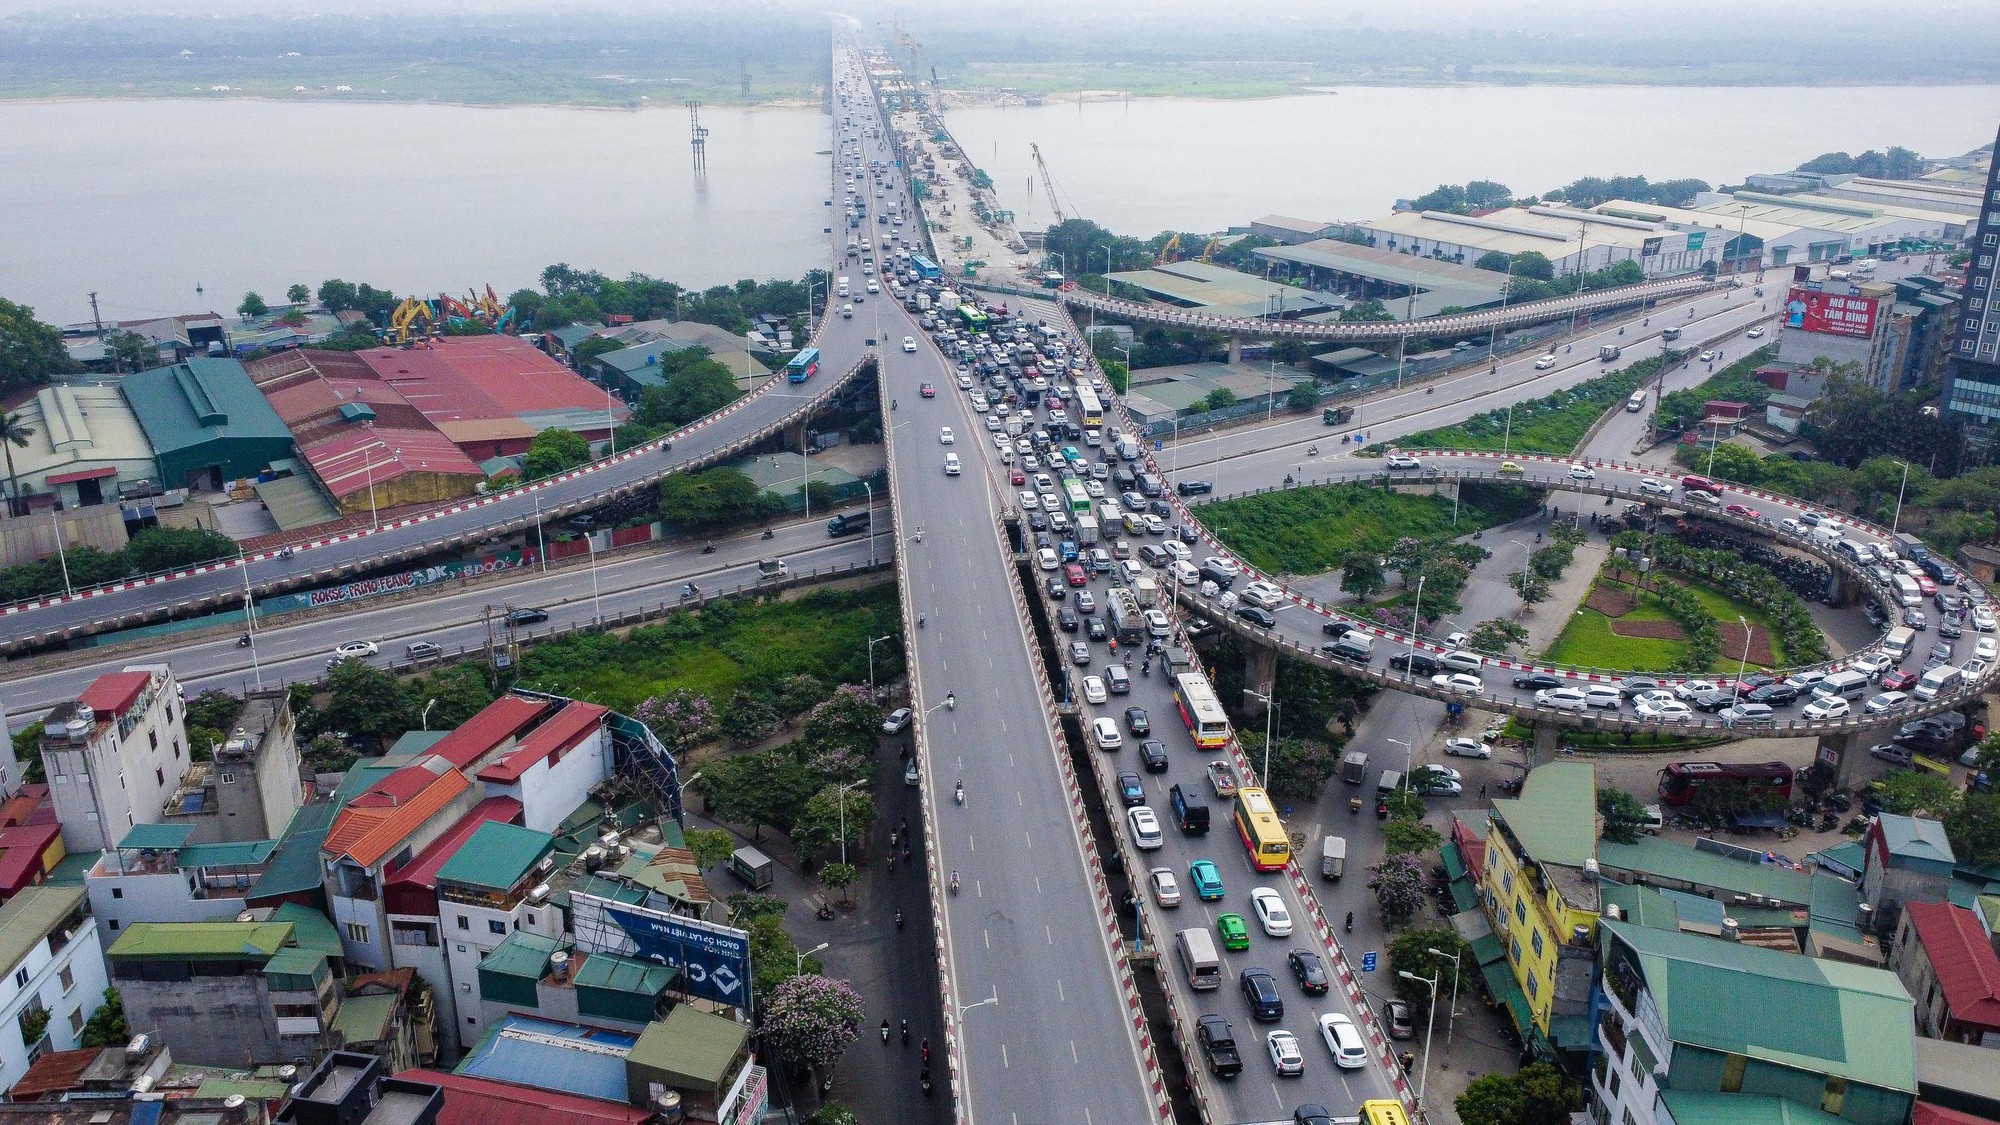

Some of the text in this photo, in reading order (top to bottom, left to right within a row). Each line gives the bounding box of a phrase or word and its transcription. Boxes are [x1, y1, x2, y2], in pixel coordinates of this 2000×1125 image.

[1846, 299, 1868, 311] MÁU
[651, 923, 670, 933] NAM
[716, 938, 740, 950] GẠCH
